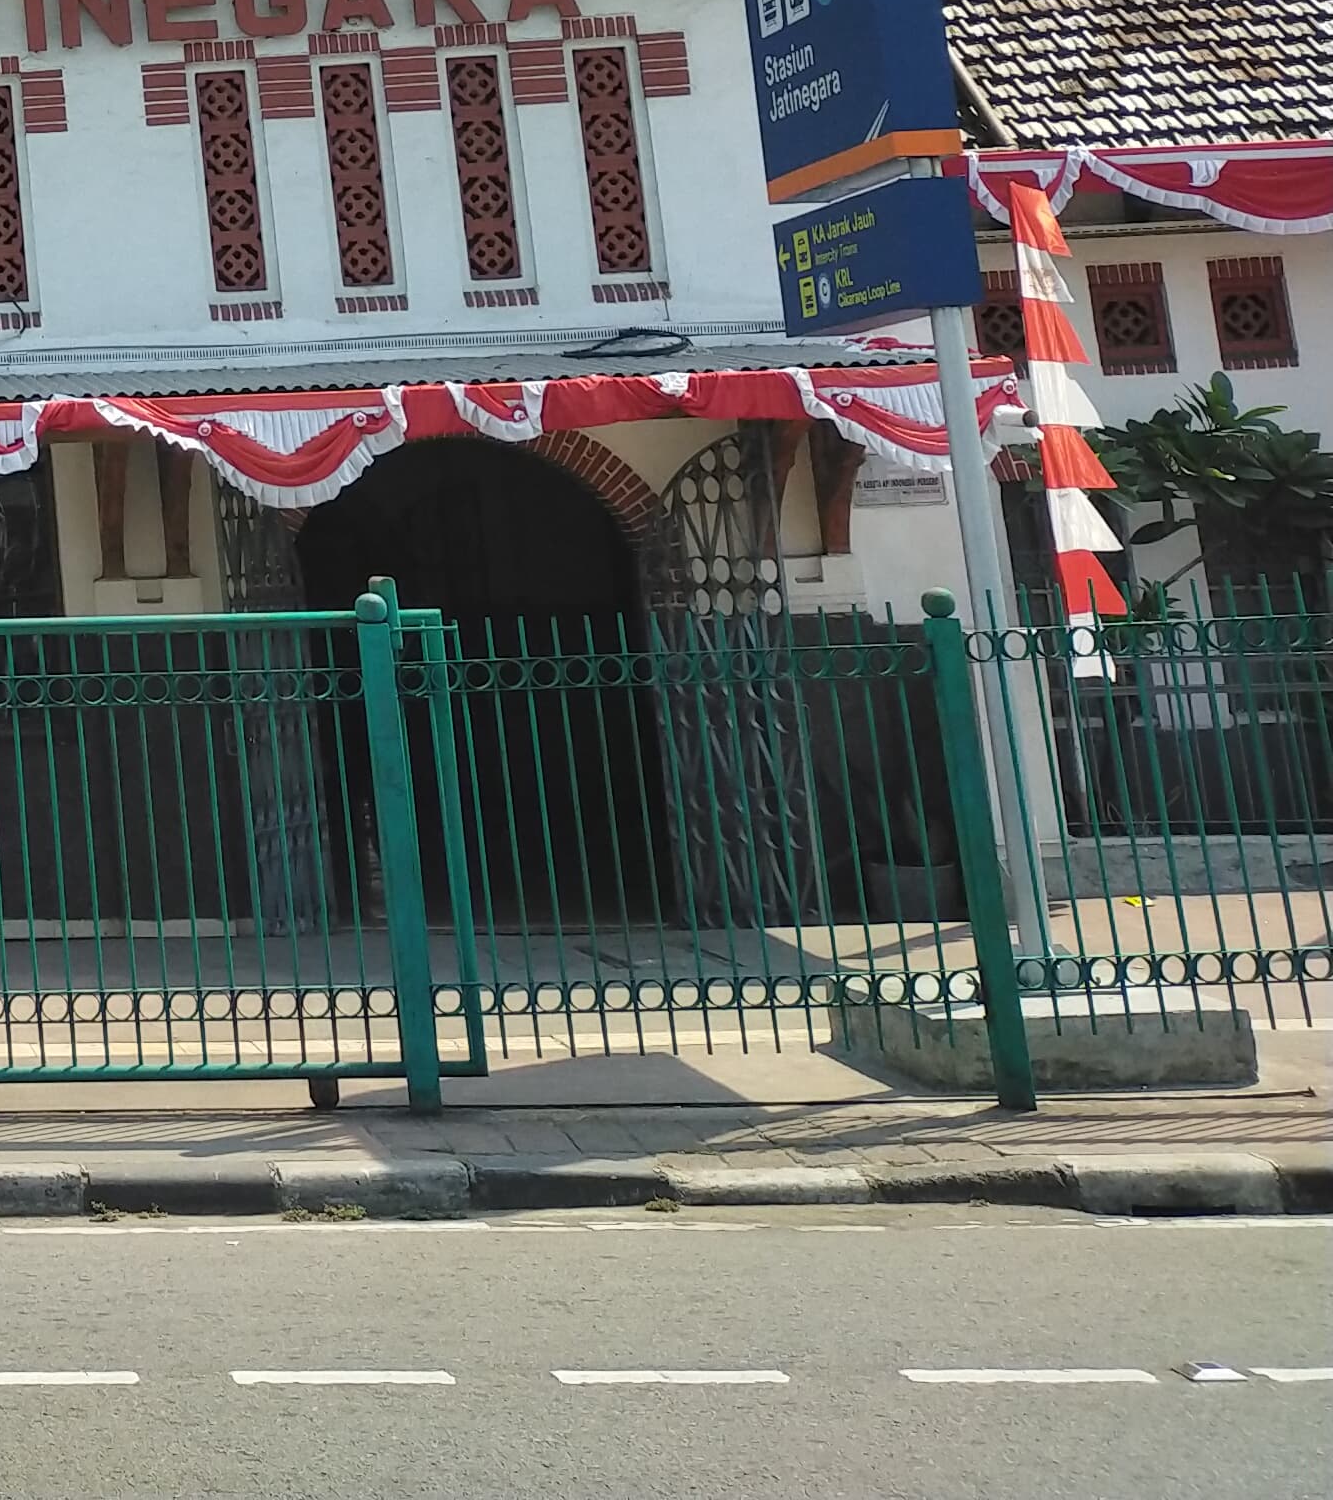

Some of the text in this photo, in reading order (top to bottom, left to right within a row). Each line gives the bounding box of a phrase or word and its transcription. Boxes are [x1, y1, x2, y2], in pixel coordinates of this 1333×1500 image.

[764, 43, 815, 87] Stasiun
[769, 69, 842, 122] Jatinegara
[811, 207, 875, 245] KA Jarak Jauh
[834, 267, 854, 289] KRL
[866, 285, 886, 301] Loop
